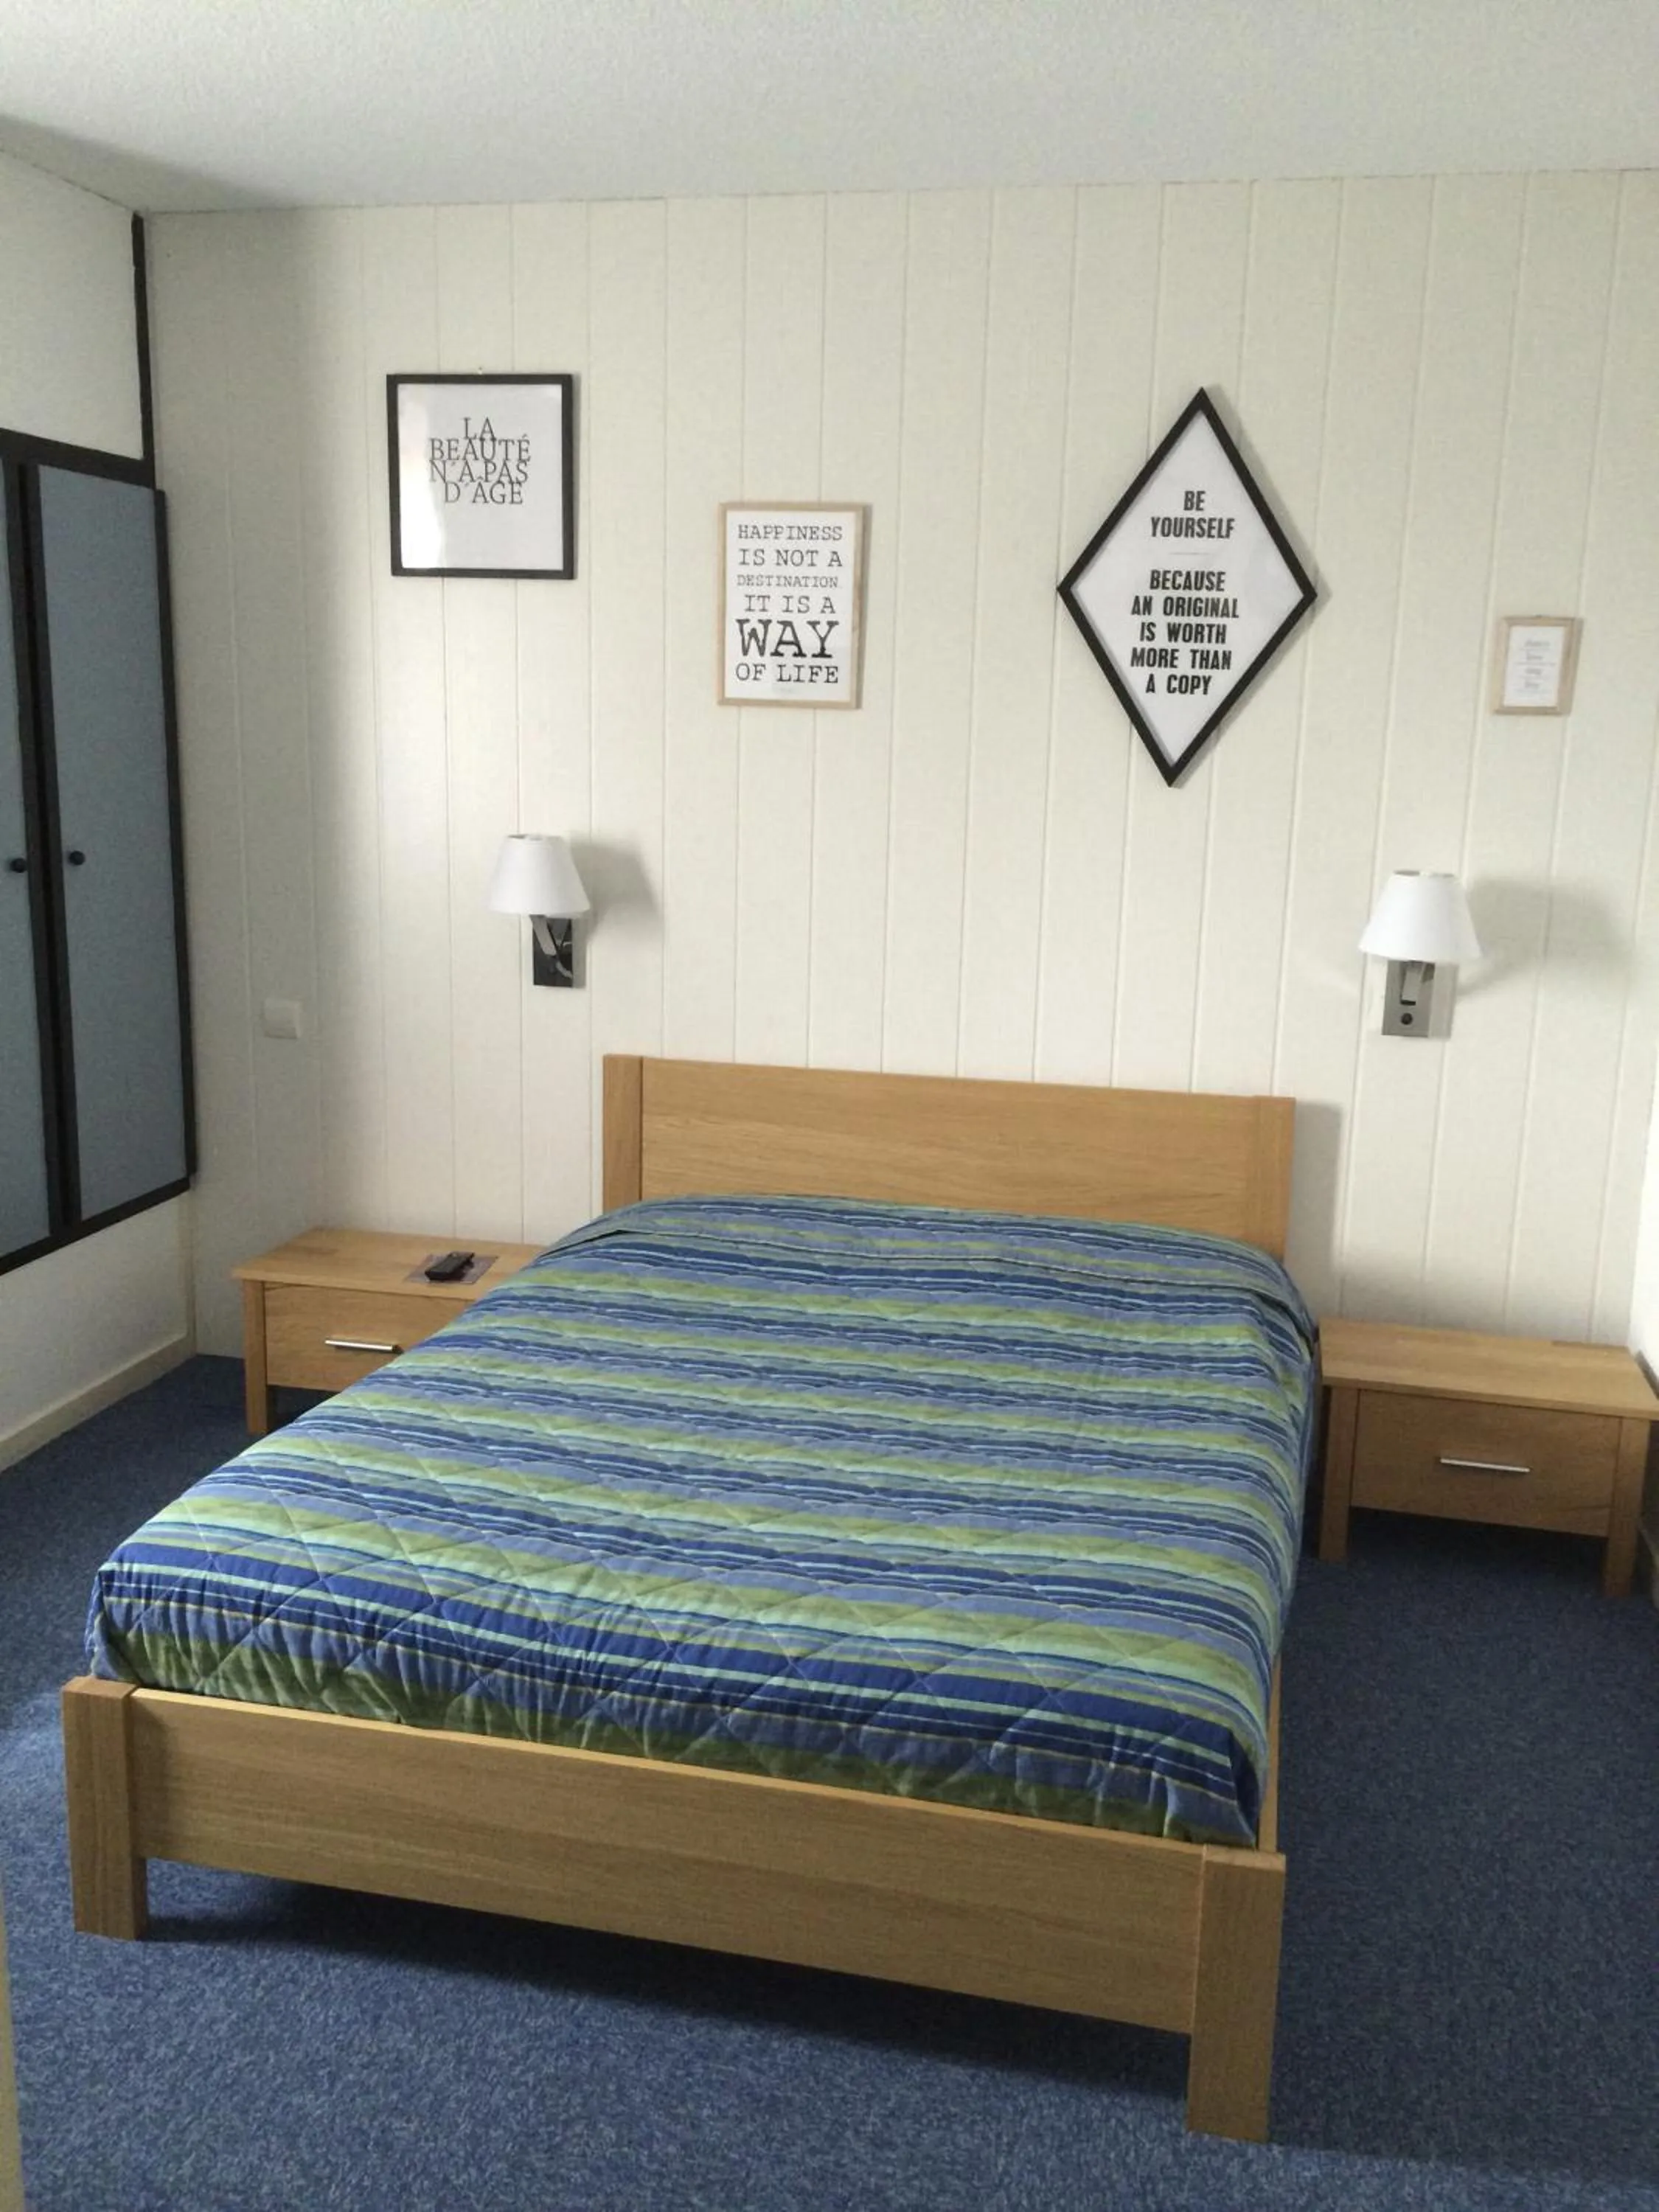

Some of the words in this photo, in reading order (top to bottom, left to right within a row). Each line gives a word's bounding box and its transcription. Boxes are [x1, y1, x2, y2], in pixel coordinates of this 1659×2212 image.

[463, 417, 496, 441] LA
[429, 434, 531, 462] BEAUTÉ
[483, 459, 529, 484] PAS
[1183, 490, 1206, 511] BE
[737, 524, 843, 540] HAPPINESS
[1150, 517, 1235, 538] YOURSELF
[738, 549, 765, 566] IS
[775, 549, 818, 566] NOT
[828, 551, 843, 567] A
[737, 574, 838, 588] DESTINATION
[1150, 569, 1226, 591] BECAUSE
[745, 594, 771, 612] IT
[782, 595, 810, 613] IS
[820, 597, 836, 614] A
[1130, 595, 1153, 616] AN
[1163, 597, 1239, 619] ORIGINAL
[735, 618, 840, 658] WAY
[1139, 622, 1156, 641] IS
[1166, 623, 1227, 644] WORTH
[1130, 647, 1180, 669] MORE
[1189, 649, 1232, 670] THAN
[735, 662, 766, 681] OF
[776, 664, 839, 684] LIFE
[1145, 673, 1156, 694] A
[1166, 674, 1212, 695] COPY
